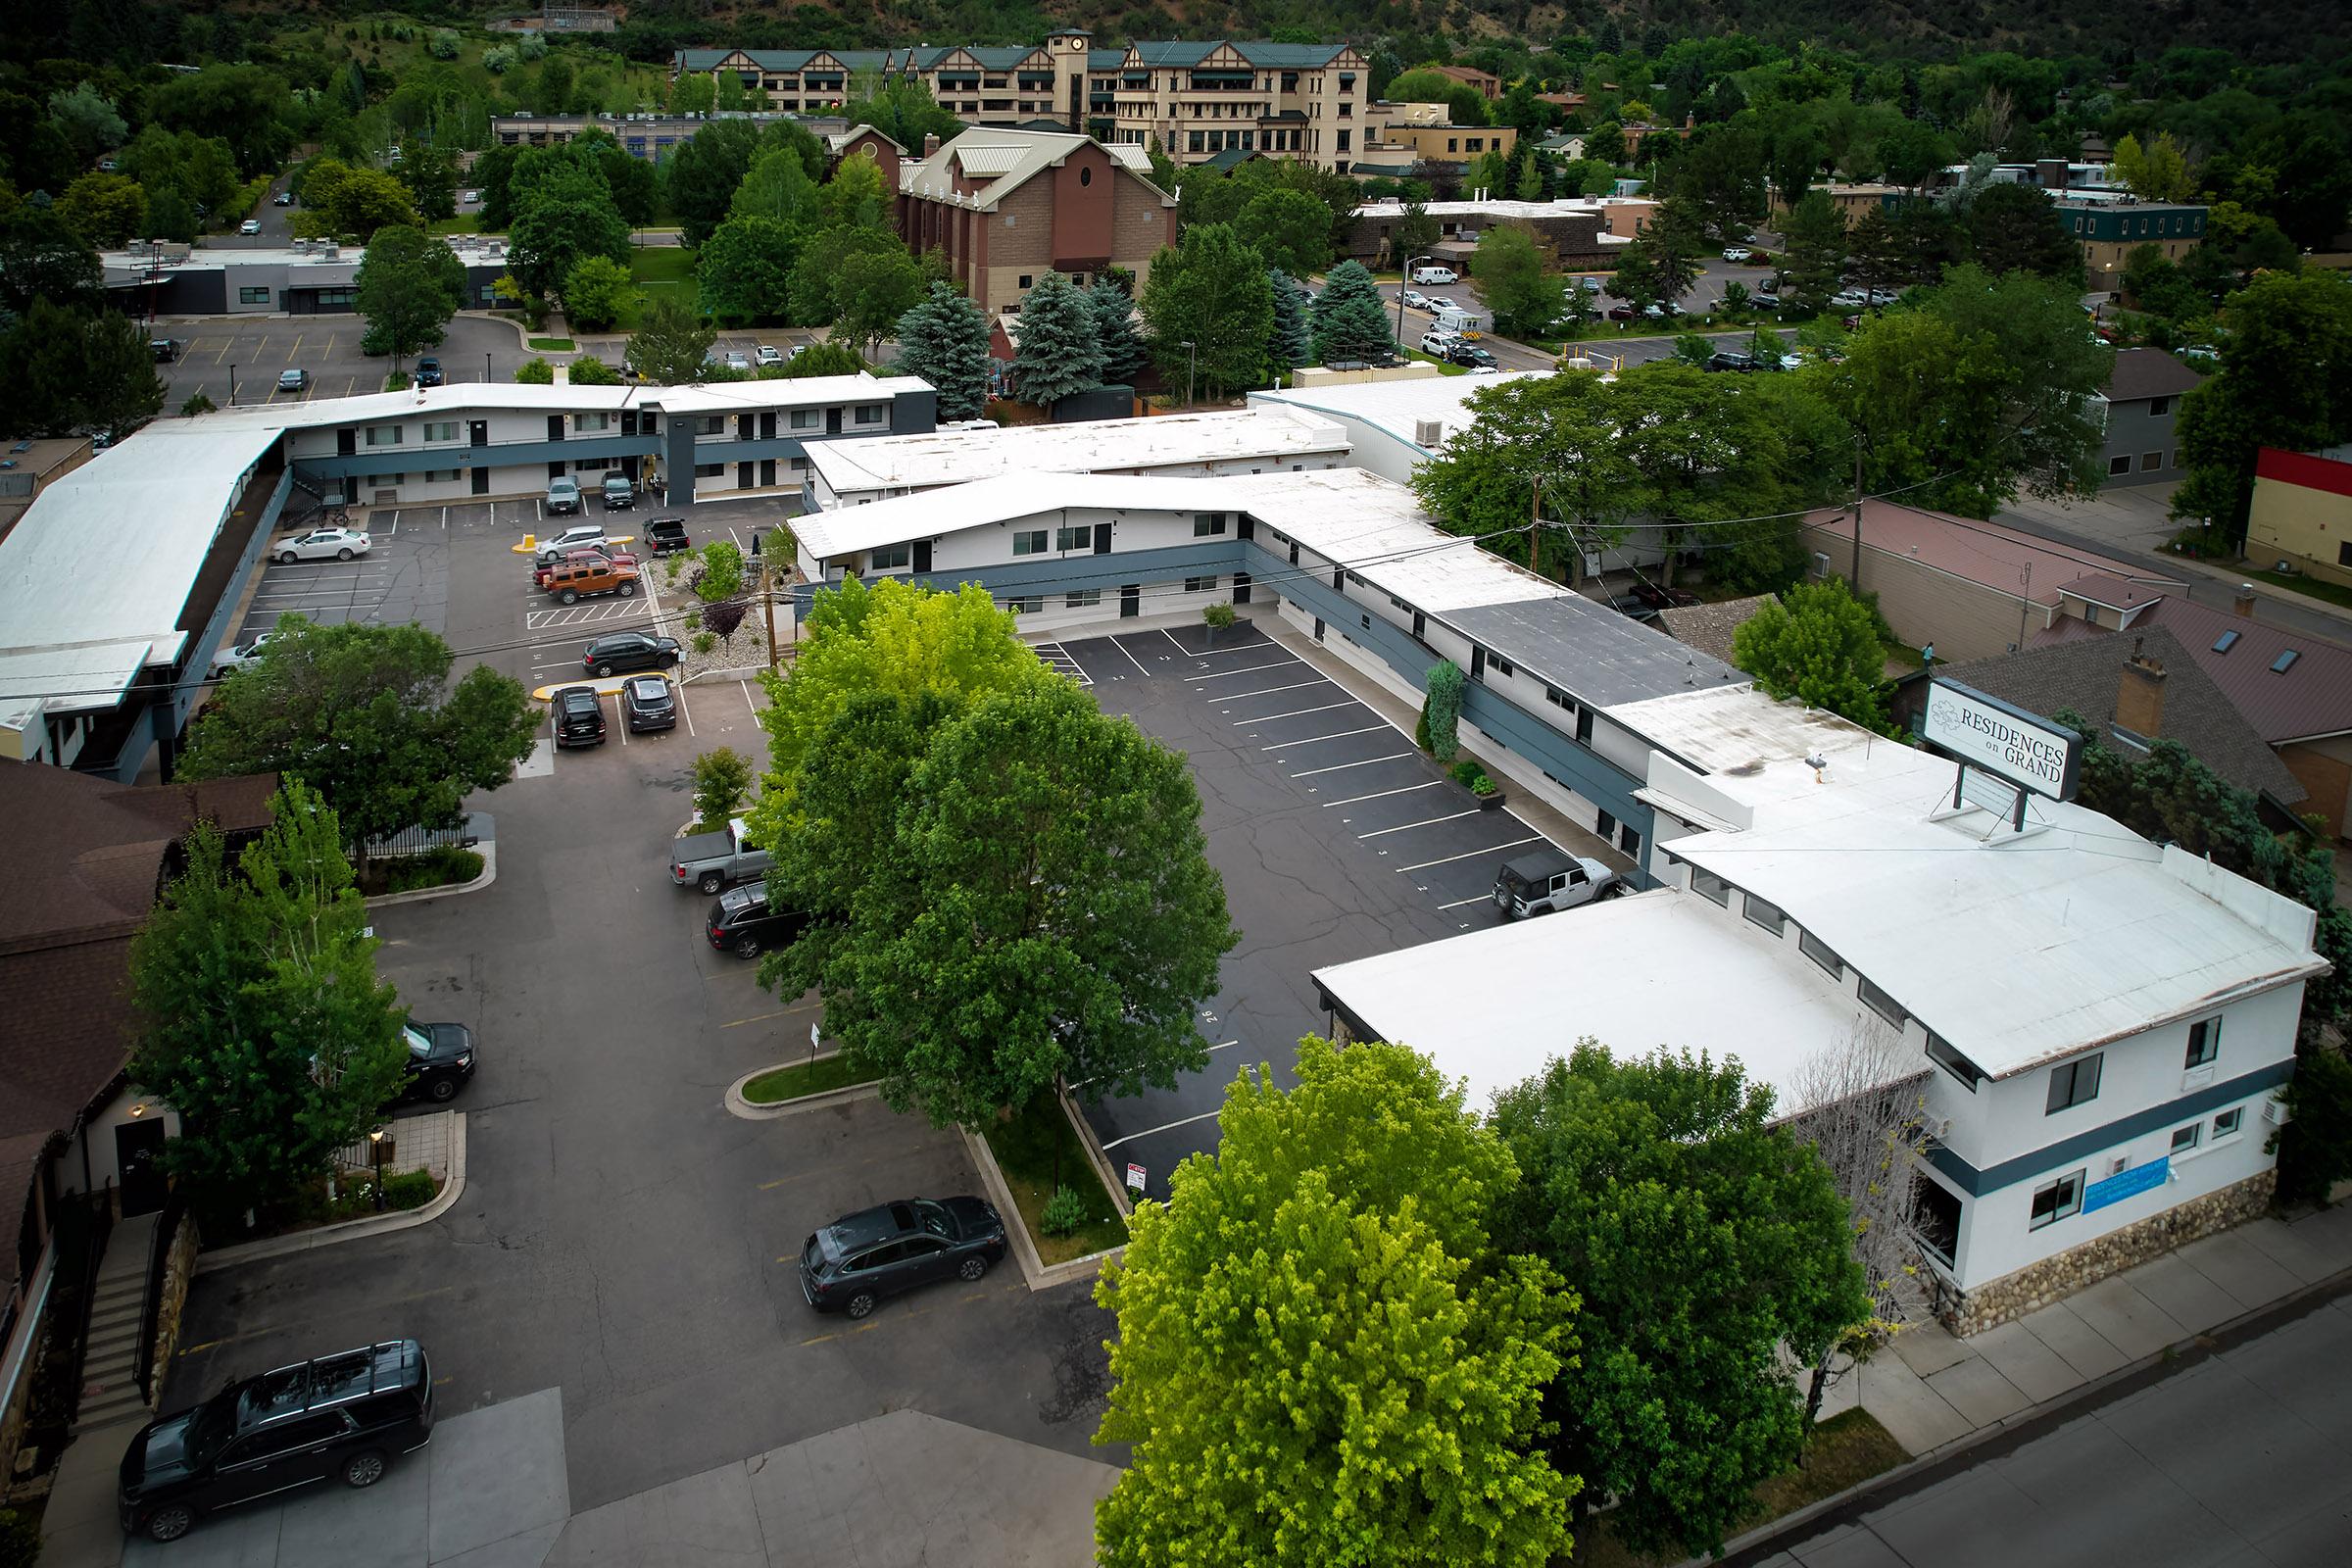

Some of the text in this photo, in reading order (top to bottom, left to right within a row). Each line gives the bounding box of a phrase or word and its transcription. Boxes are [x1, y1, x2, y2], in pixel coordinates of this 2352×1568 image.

[1961, 707, 2064, 766] RESIDENCES
[1985, 739, 2061, 784] on GRAND
[1201, 1010, 1218, 1023] 26
[1134, 1165, 1146, 1175] STOP
